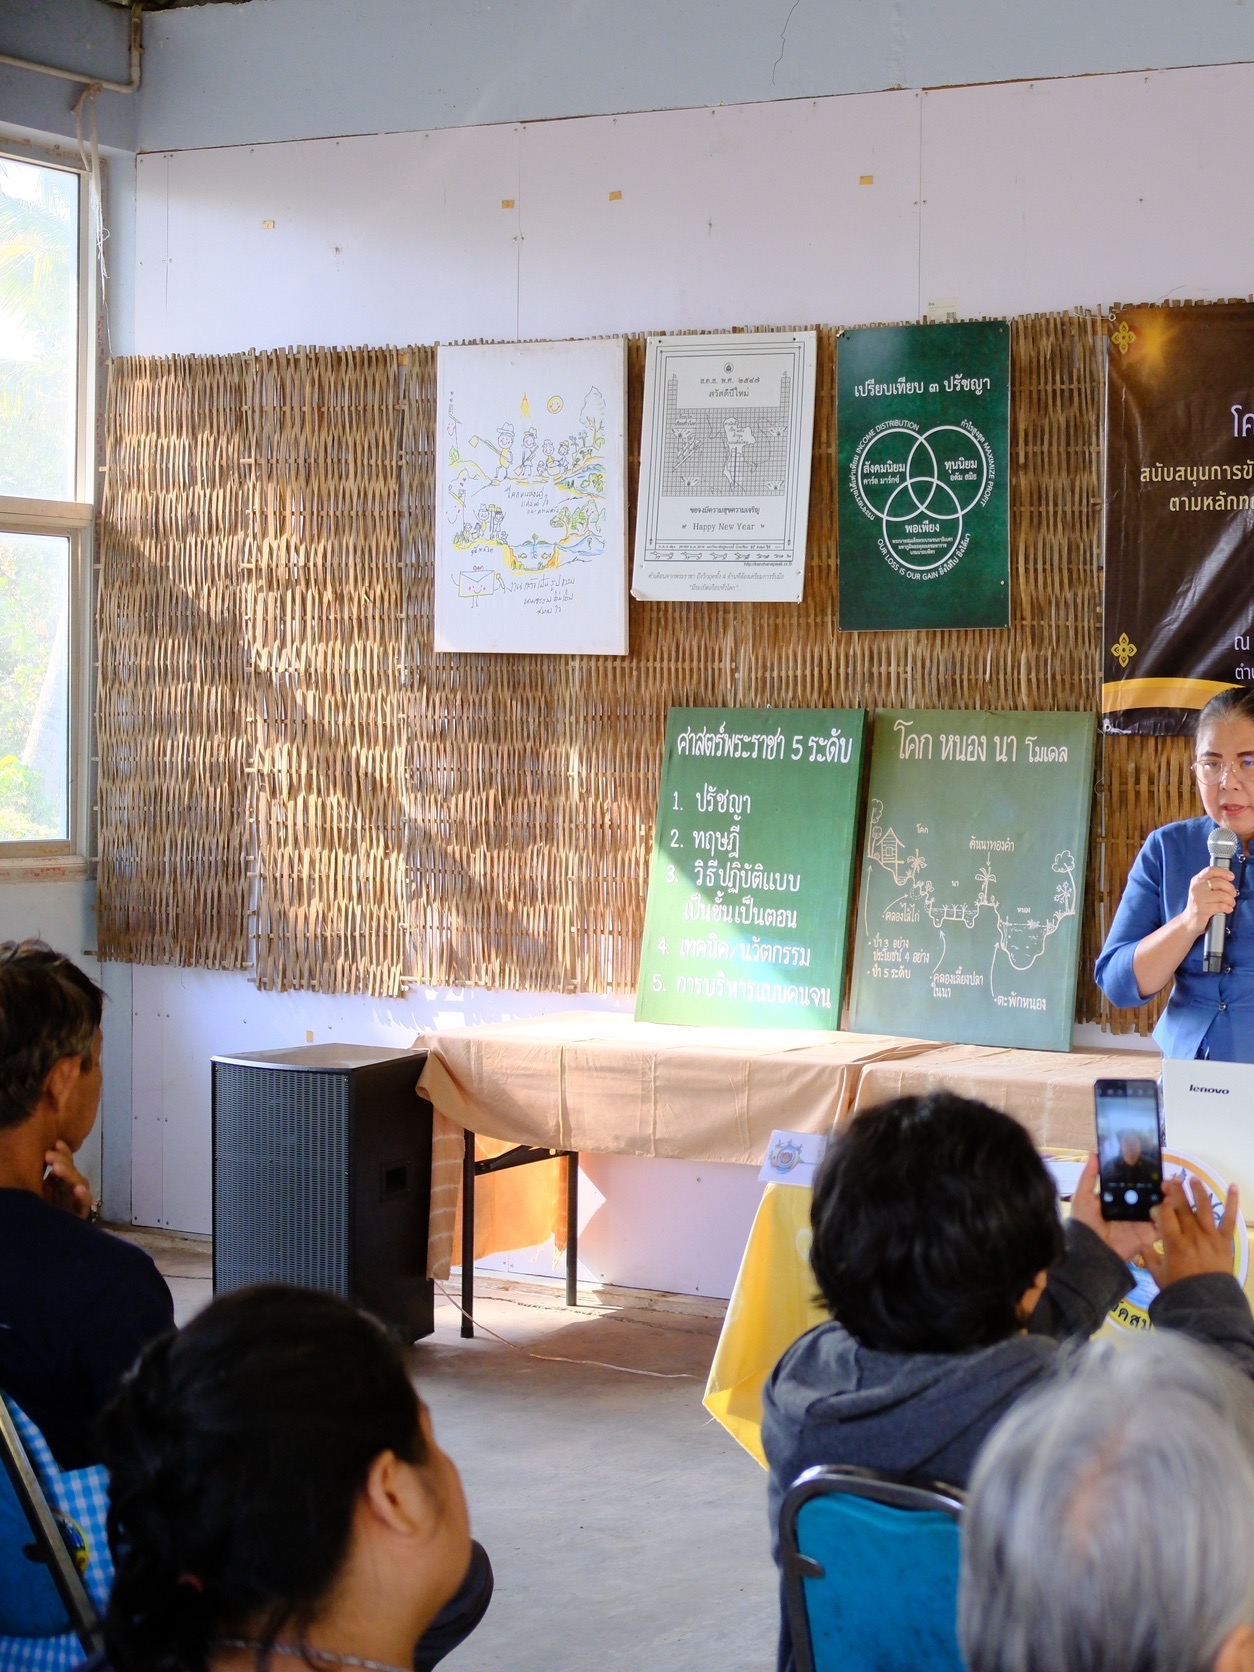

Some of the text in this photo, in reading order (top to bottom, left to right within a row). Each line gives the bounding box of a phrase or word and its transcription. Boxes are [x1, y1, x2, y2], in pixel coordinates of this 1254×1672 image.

[708, 386, 750, 398] สวัสดีปีใหม่
[854, 373, 991, 398] เปรียบเทียบ ๓ ปรัชญา
[857, 419, 920, 455] INCOME DISTRIBUTION
[863, 459, 906, 474] สังคมนิยม
[944, 456, 978, 474] ทุนนิยม
[980, 442, 996, 507] MAXIMIZE PROFIT
[692, 522, 755, 532] Happy New Year
[905, 519, 940, 534] พอเพียง
[877, 538, 939, 581] OUR LOSS IS OUR GAIN
[1234, 634, 1250, 652] ณ
[677, 721, 853, 764] ศาสตร์พระราชา 5 ระดับ
[894, 719, 1068, 763] โคก หนอง นา โมเดล
[672, 782, 751, 821] 1. ปรัชญา
[916, 823, 929, 834] โคก
[670, 824, 741, 858] 2. ทฤษฎี
[694, 860, 801, 894] วิธีปฏิบัติแบบ
[1016, 906, 1031, 914] หนอง
[883, 968, 889, 978] 5
[891, 965, 911, 979] ระดับ
[933, 965, 984, 986] คลองเลี้ยงปลา
[676, 973, 832, 1009] การบริหารแบบคนจน
[931, 982, 952, 998] ในนา
[1189, 1084, 1230, 1095] lenovo
